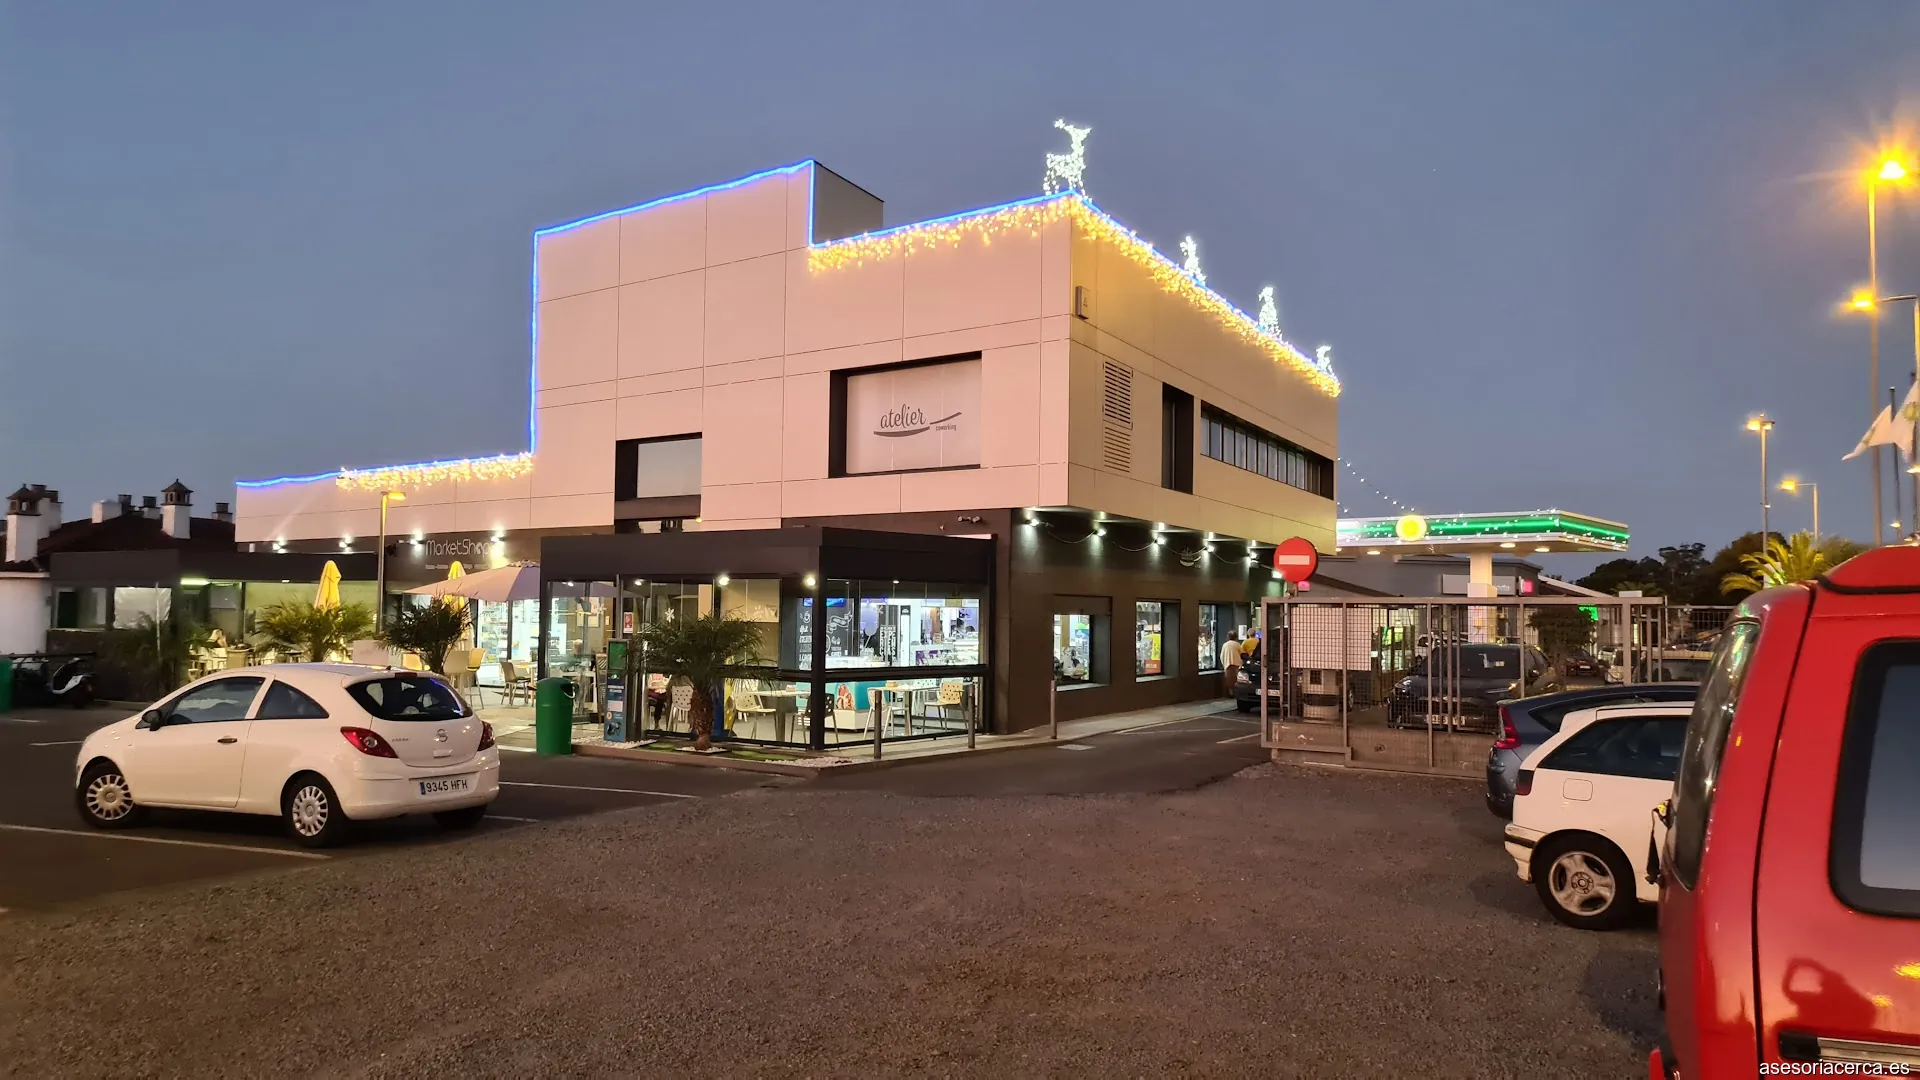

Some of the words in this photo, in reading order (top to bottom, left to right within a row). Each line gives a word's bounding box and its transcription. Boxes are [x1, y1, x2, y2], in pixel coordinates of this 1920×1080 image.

[880, 403, 927, 429] atelier
[426, 781, 449, 793] 9345
[450, 779, 468, 791] HFH
